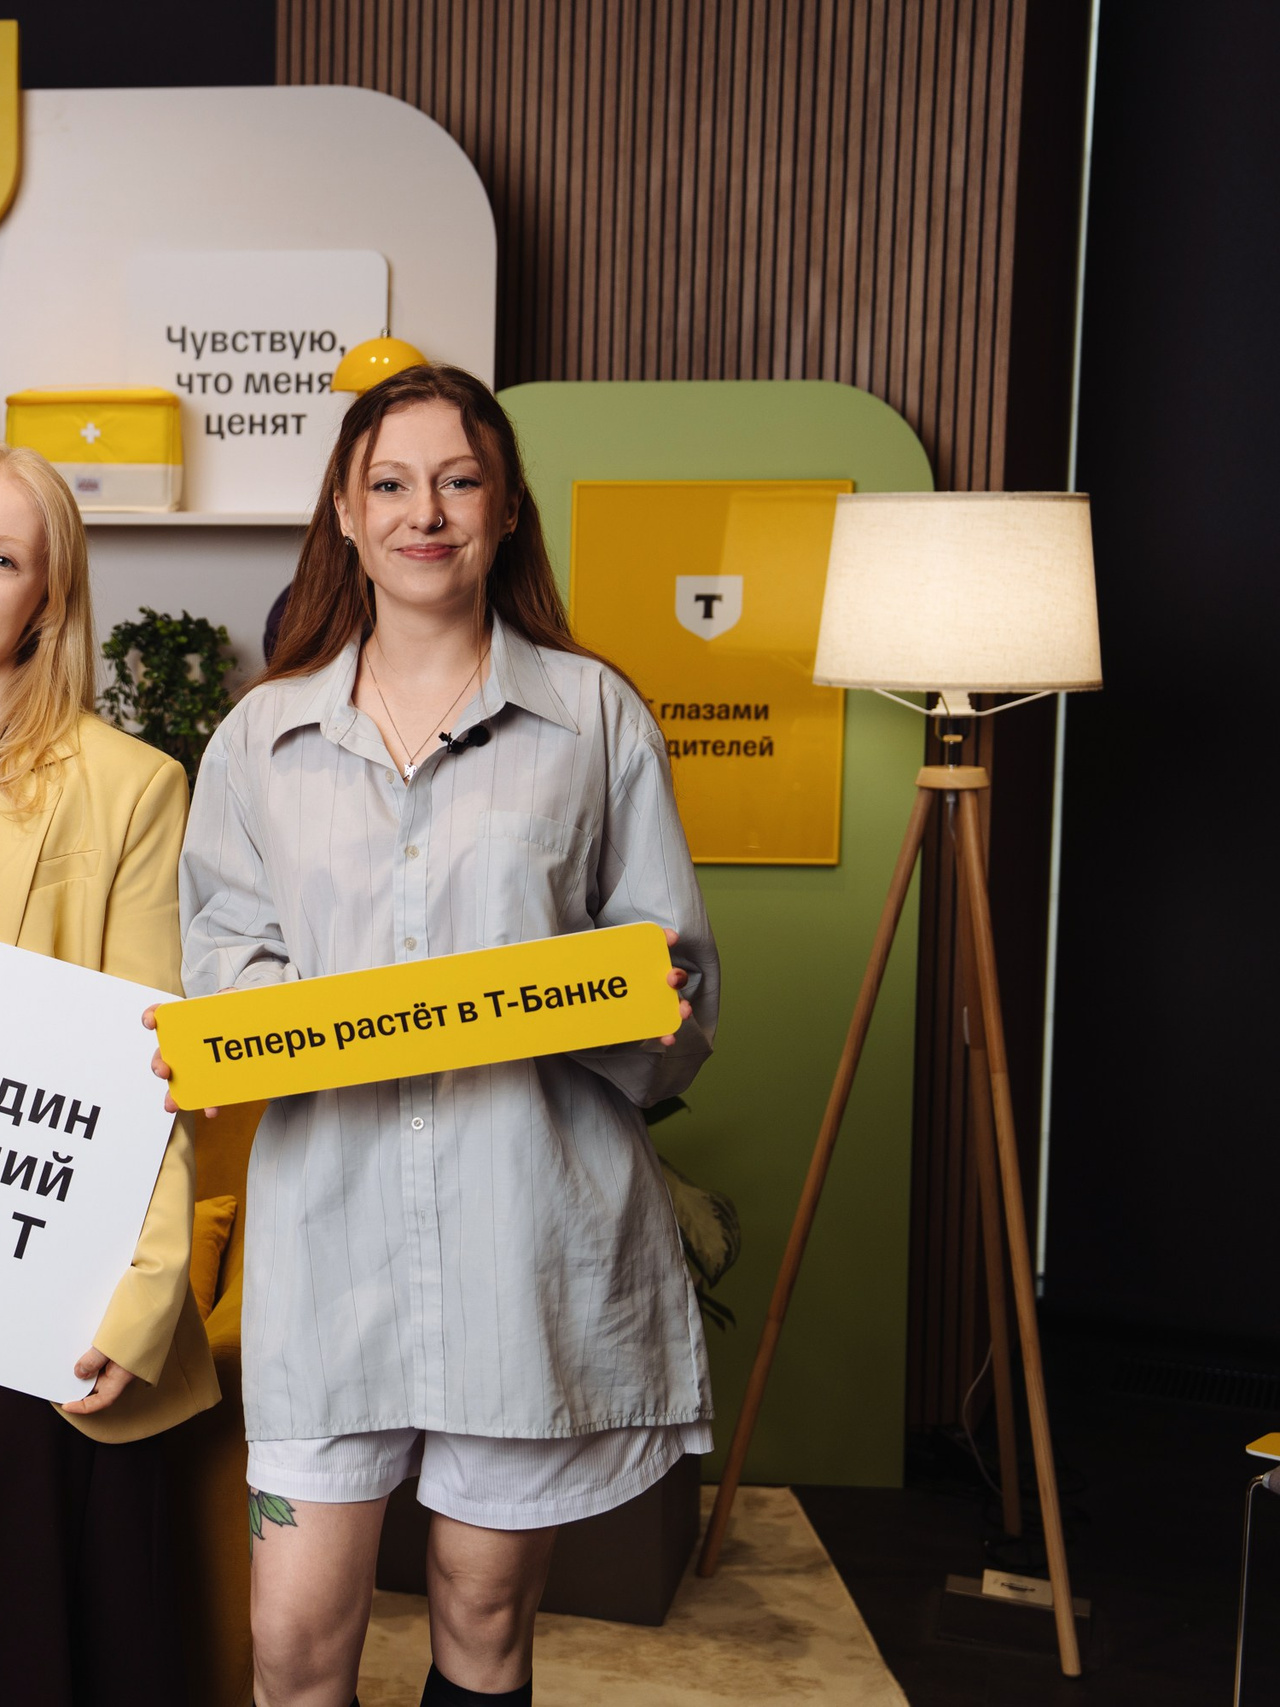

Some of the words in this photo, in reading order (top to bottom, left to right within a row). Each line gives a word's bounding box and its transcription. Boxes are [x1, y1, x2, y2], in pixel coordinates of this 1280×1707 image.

[166, 325, 346, 360] Чувствую,
[176, 371, 233, 395] что
[244, 371, 334, 395] меня
[205, 413, 307, 440] ценят
[694, 593, 723, 620] Т
[660, 702, 770, 721] глазами
[668, 736, 774, 760] дителей
[203, 1026, 326, 1063] Теперь
[333, 1002, 448, 1050] растёт
[457, 1001, 479, 1024] в
[483, 976, 628, 1018] Т-Банке
[11, 1211, 47, 1260] Т
